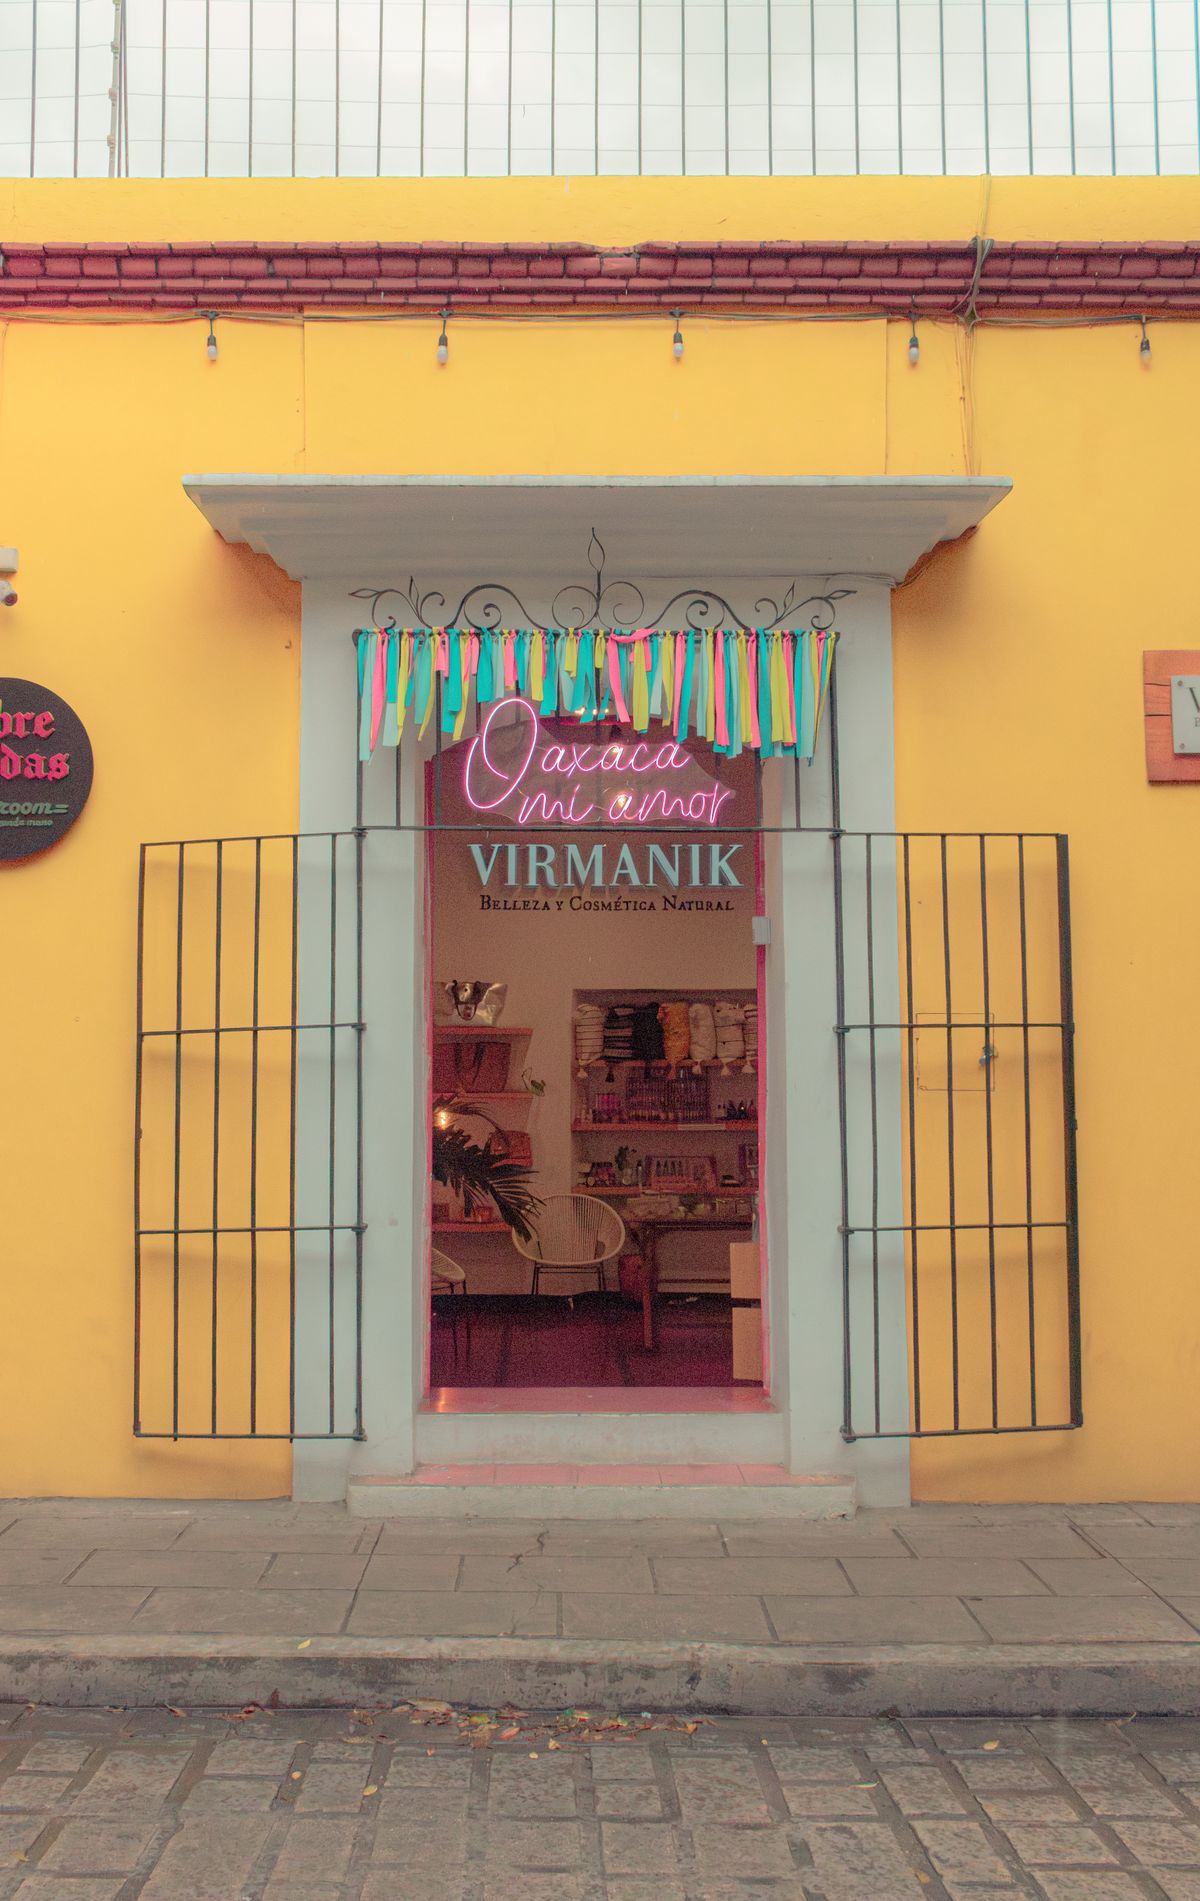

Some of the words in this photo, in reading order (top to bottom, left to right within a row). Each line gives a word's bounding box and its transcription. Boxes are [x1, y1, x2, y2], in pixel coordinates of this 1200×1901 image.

[0, 743, 69, 780] das
[465, 698, 692, 809] Oaxaca
[518, 784, 594, 824] mi
[608, 783, 731, 824] amor
[467, 843, 745, 889] VIRMANIK
[480, 894, 550, 911] BELLEZA
[569, 895, 657, 911] COSMÉTICA
[662, 894, 735, 911] NATURAL
